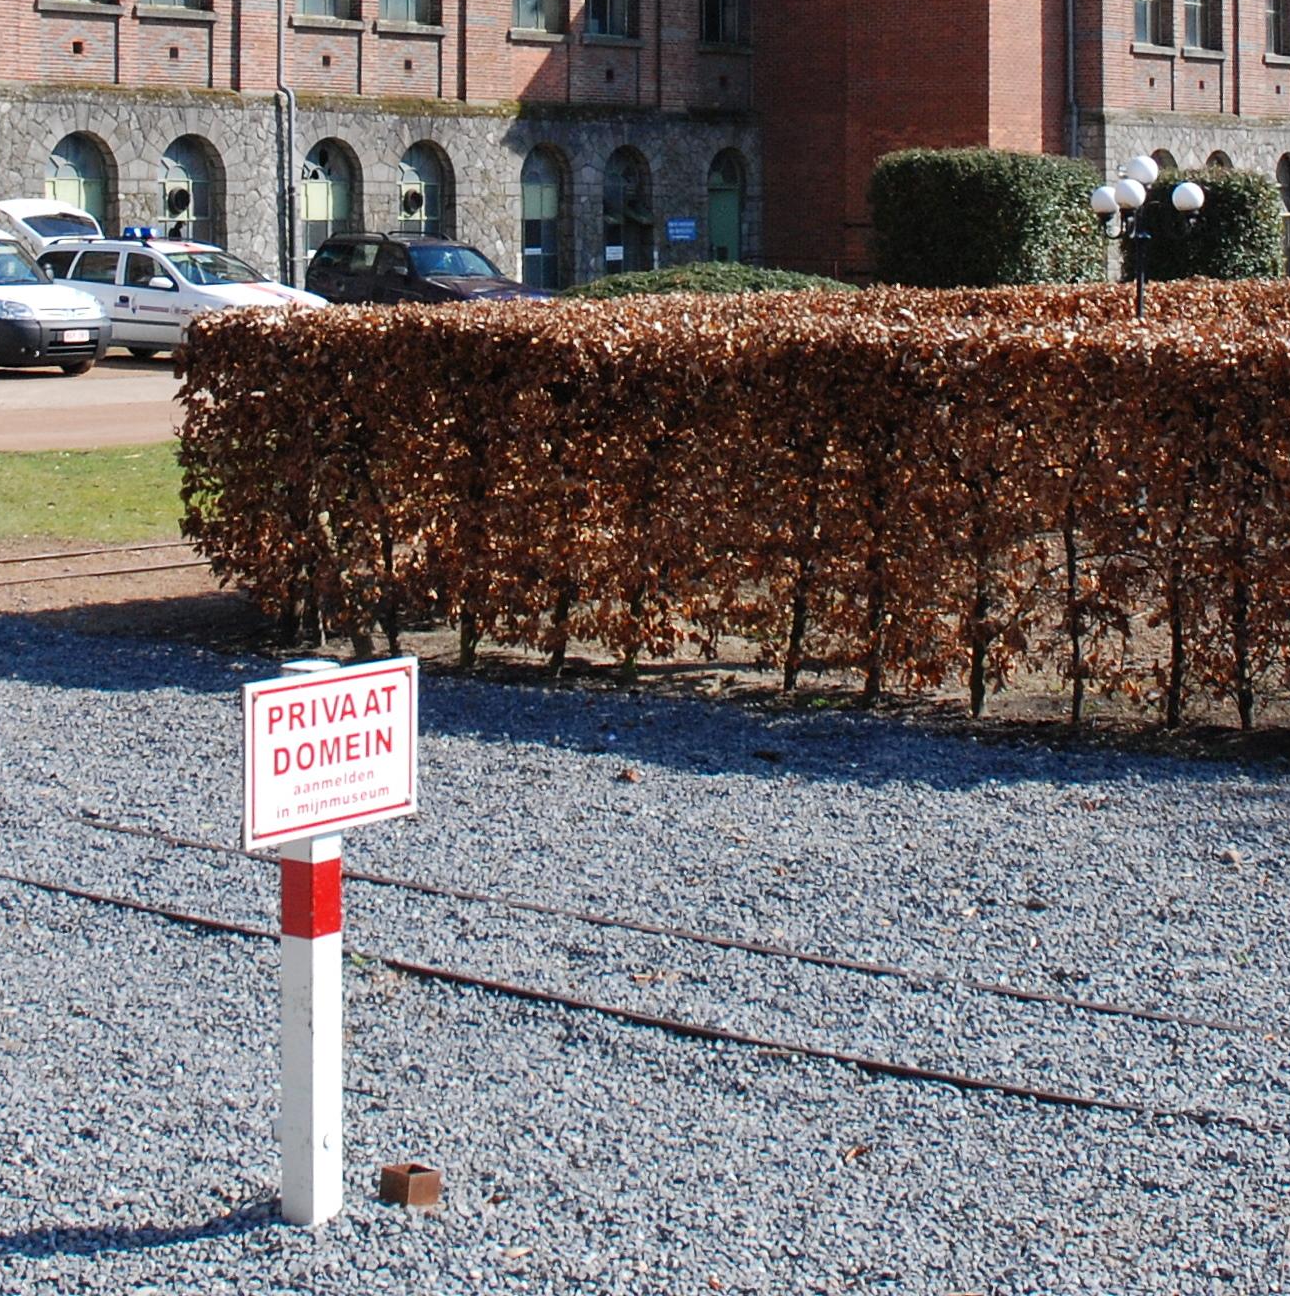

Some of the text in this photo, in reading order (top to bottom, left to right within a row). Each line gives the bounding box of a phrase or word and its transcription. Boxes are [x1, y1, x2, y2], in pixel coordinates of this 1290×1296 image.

[268, 685, 397, 734] PRIVAAT
[273, 726, 393, 776] DOMEIN
[276, 786, 391, 819] in mijnmuseum
[293, 769, 375, 796] aanmelden
